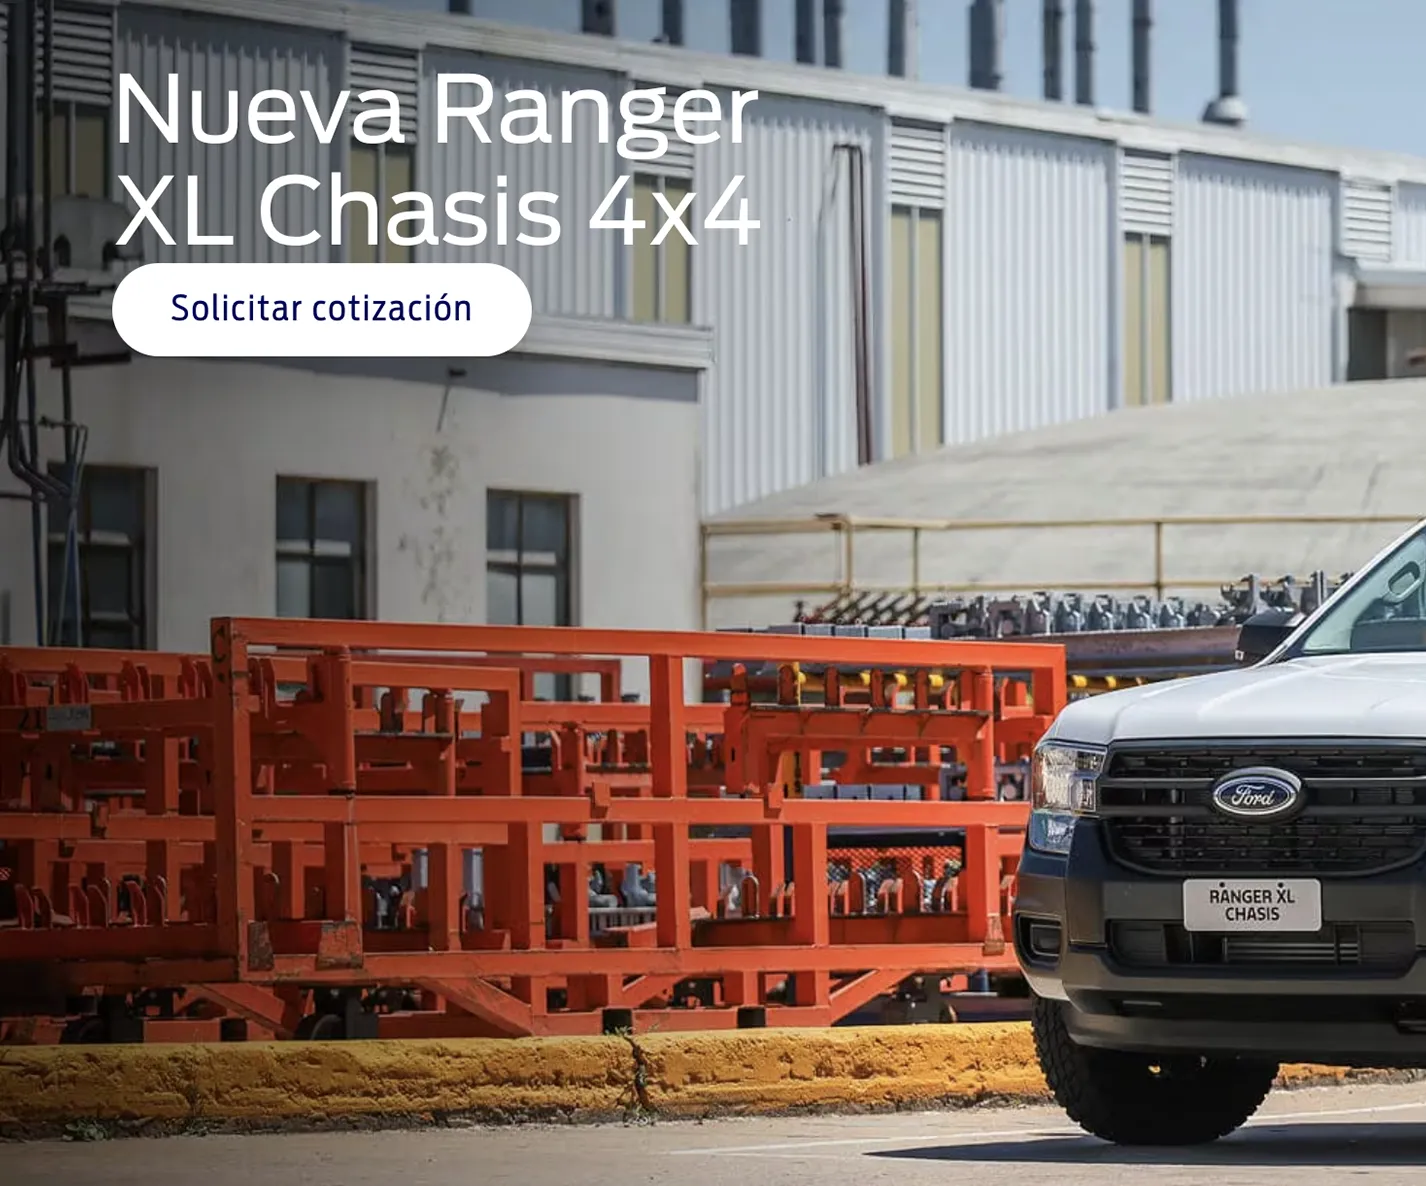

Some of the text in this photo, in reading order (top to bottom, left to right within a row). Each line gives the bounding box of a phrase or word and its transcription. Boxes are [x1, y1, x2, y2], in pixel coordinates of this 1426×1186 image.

[1231, 784, 1276, 807] Ford
[1209, 889, 1296, 904] RANGER XL
[1224, 907, 1280, 922] CHASIS
